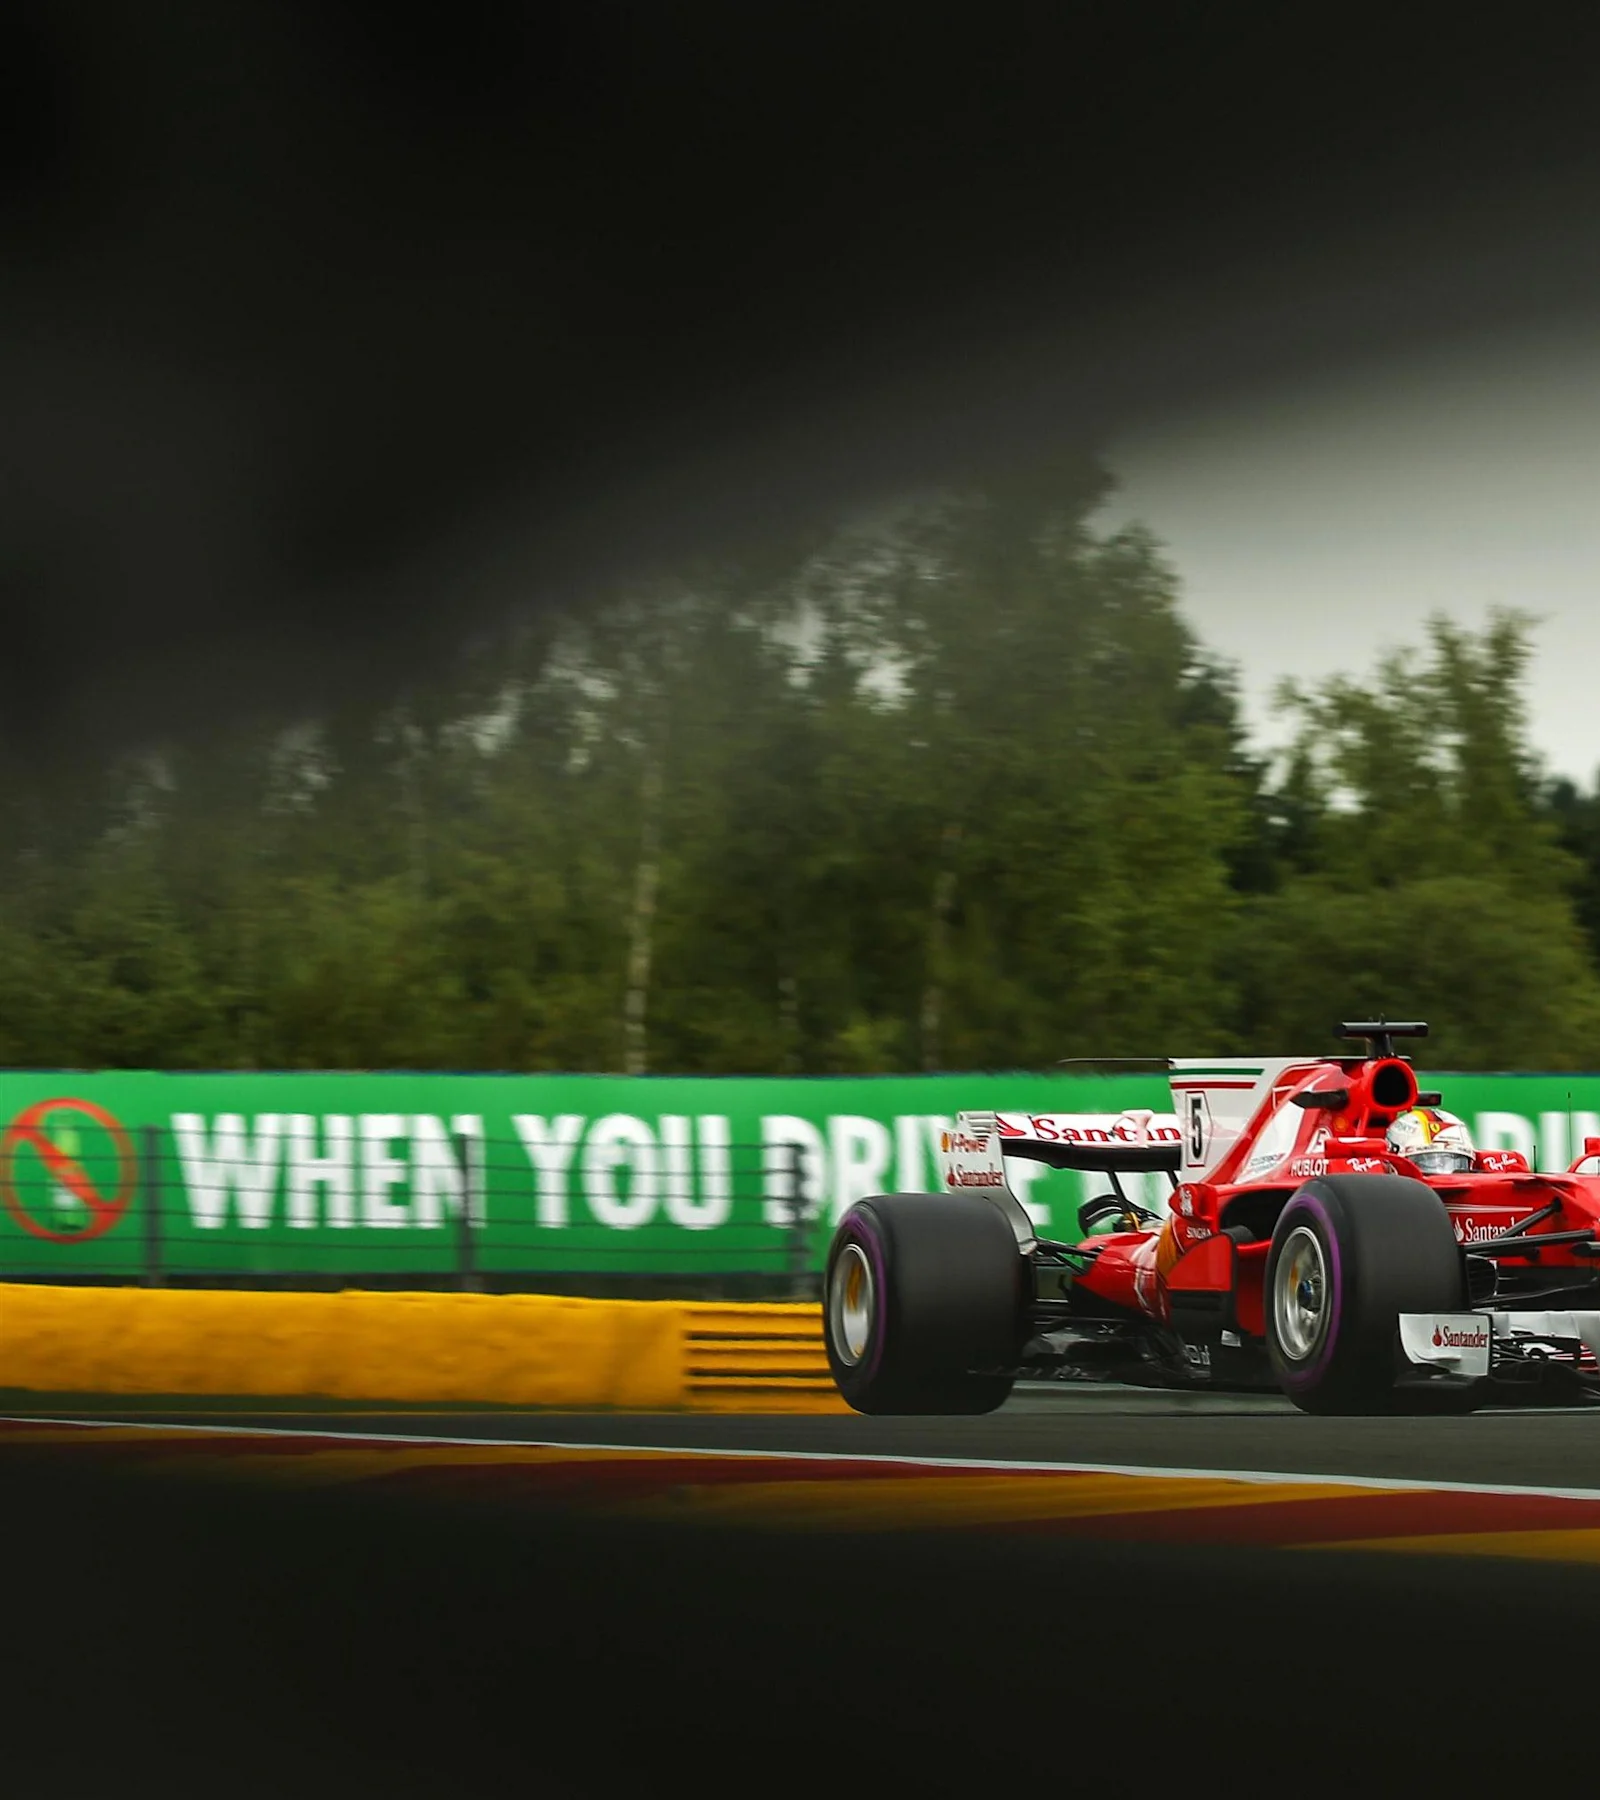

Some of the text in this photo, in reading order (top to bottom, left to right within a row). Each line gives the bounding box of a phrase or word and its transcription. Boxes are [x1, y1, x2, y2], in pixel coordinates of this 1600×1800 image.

[1190, 1097, 1203, 1159] 5
[171, 1113, 487, 1229] WHEN
[511, 1113, 732, 1230] YOU
[1290, 1158, 1331, 1178] HUBLOT
[1186, 1226, 1212, 1239] SINGHA
[1443, 1325, 1488, 1348] Santander
